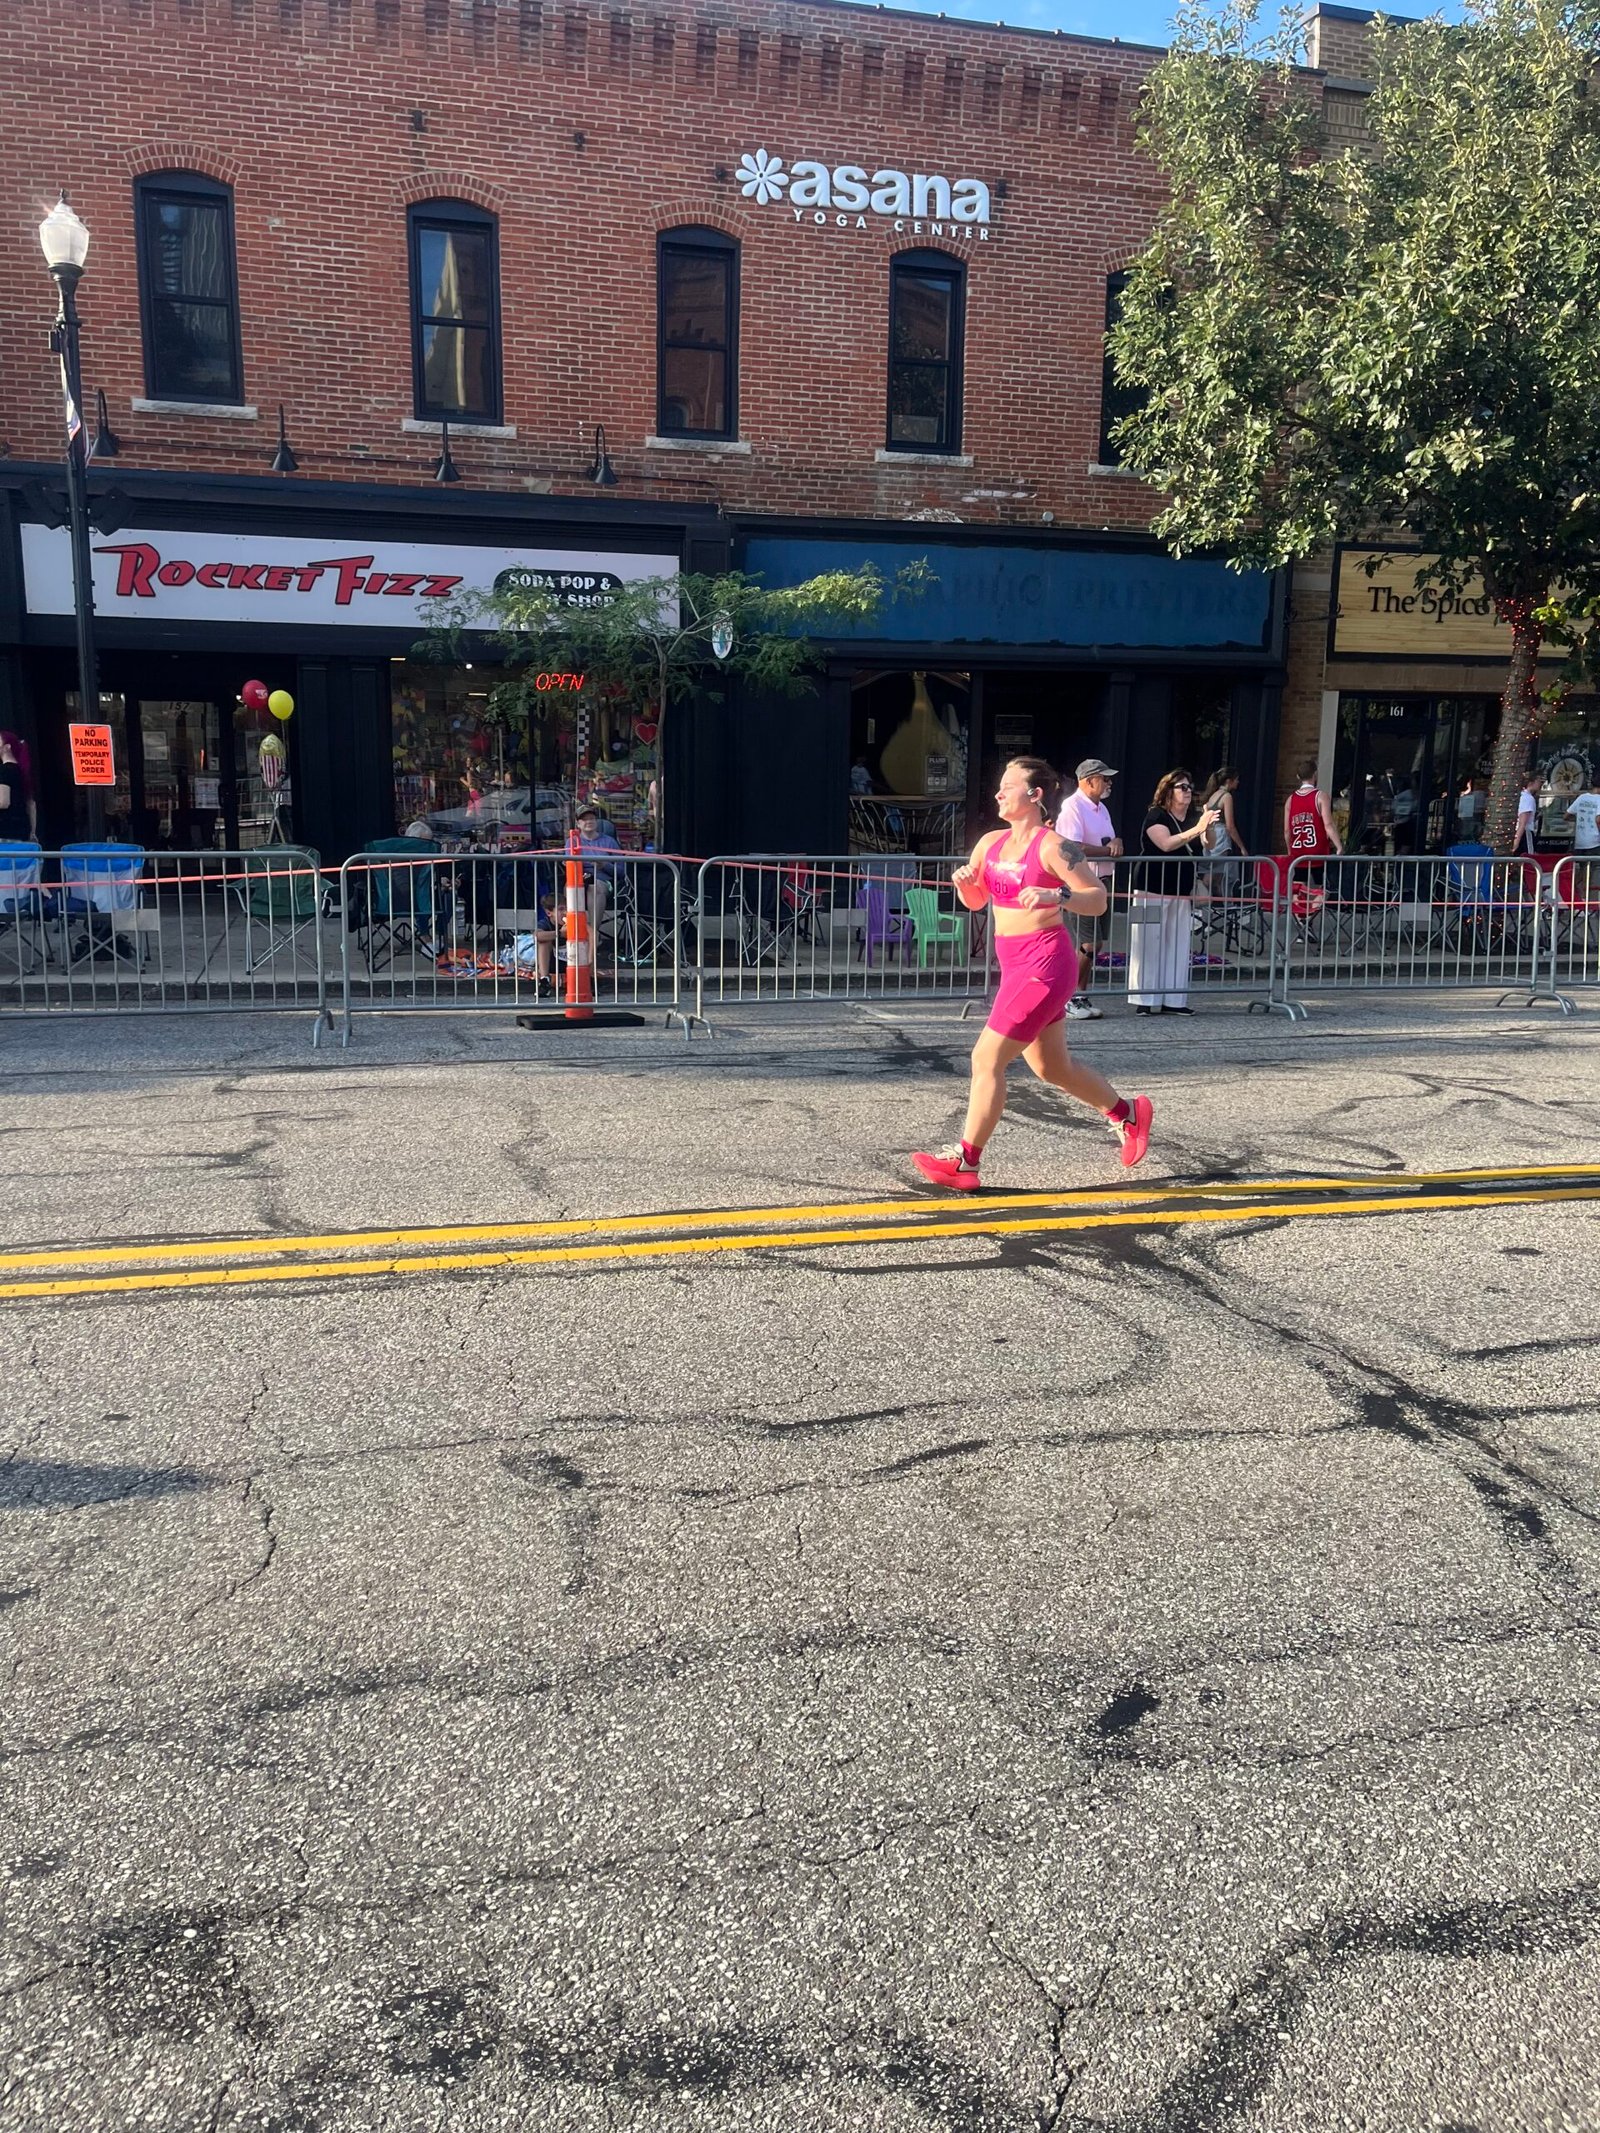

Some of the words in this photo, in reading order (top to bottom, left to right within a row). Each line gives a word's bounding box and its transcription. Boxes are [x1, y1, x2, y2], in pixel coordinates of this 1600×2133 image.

[790, 161, 991, 224] asana
[793, 209, 867, 229] YOGA
[894, 220, 990, 240] CENTER
[92, 542, 324, 597] ROCKET
[308, 555, 463, 605] FIZZ
[508, 573, 555, 588] SODA
[560, 576, 596, 590] POP
[600, 577, 611, 591] &
[1368, 586, 1415, 613] The
[1421, 588, 1487, 623] Spice
[535, 672, 584, 690] OPEN
[1390, 706, 1404, 716] 161
[75, 738, 108, 747] PARKING
[84, 729, 96, 738] NO
[1291, 824, 1317, 848] 23
